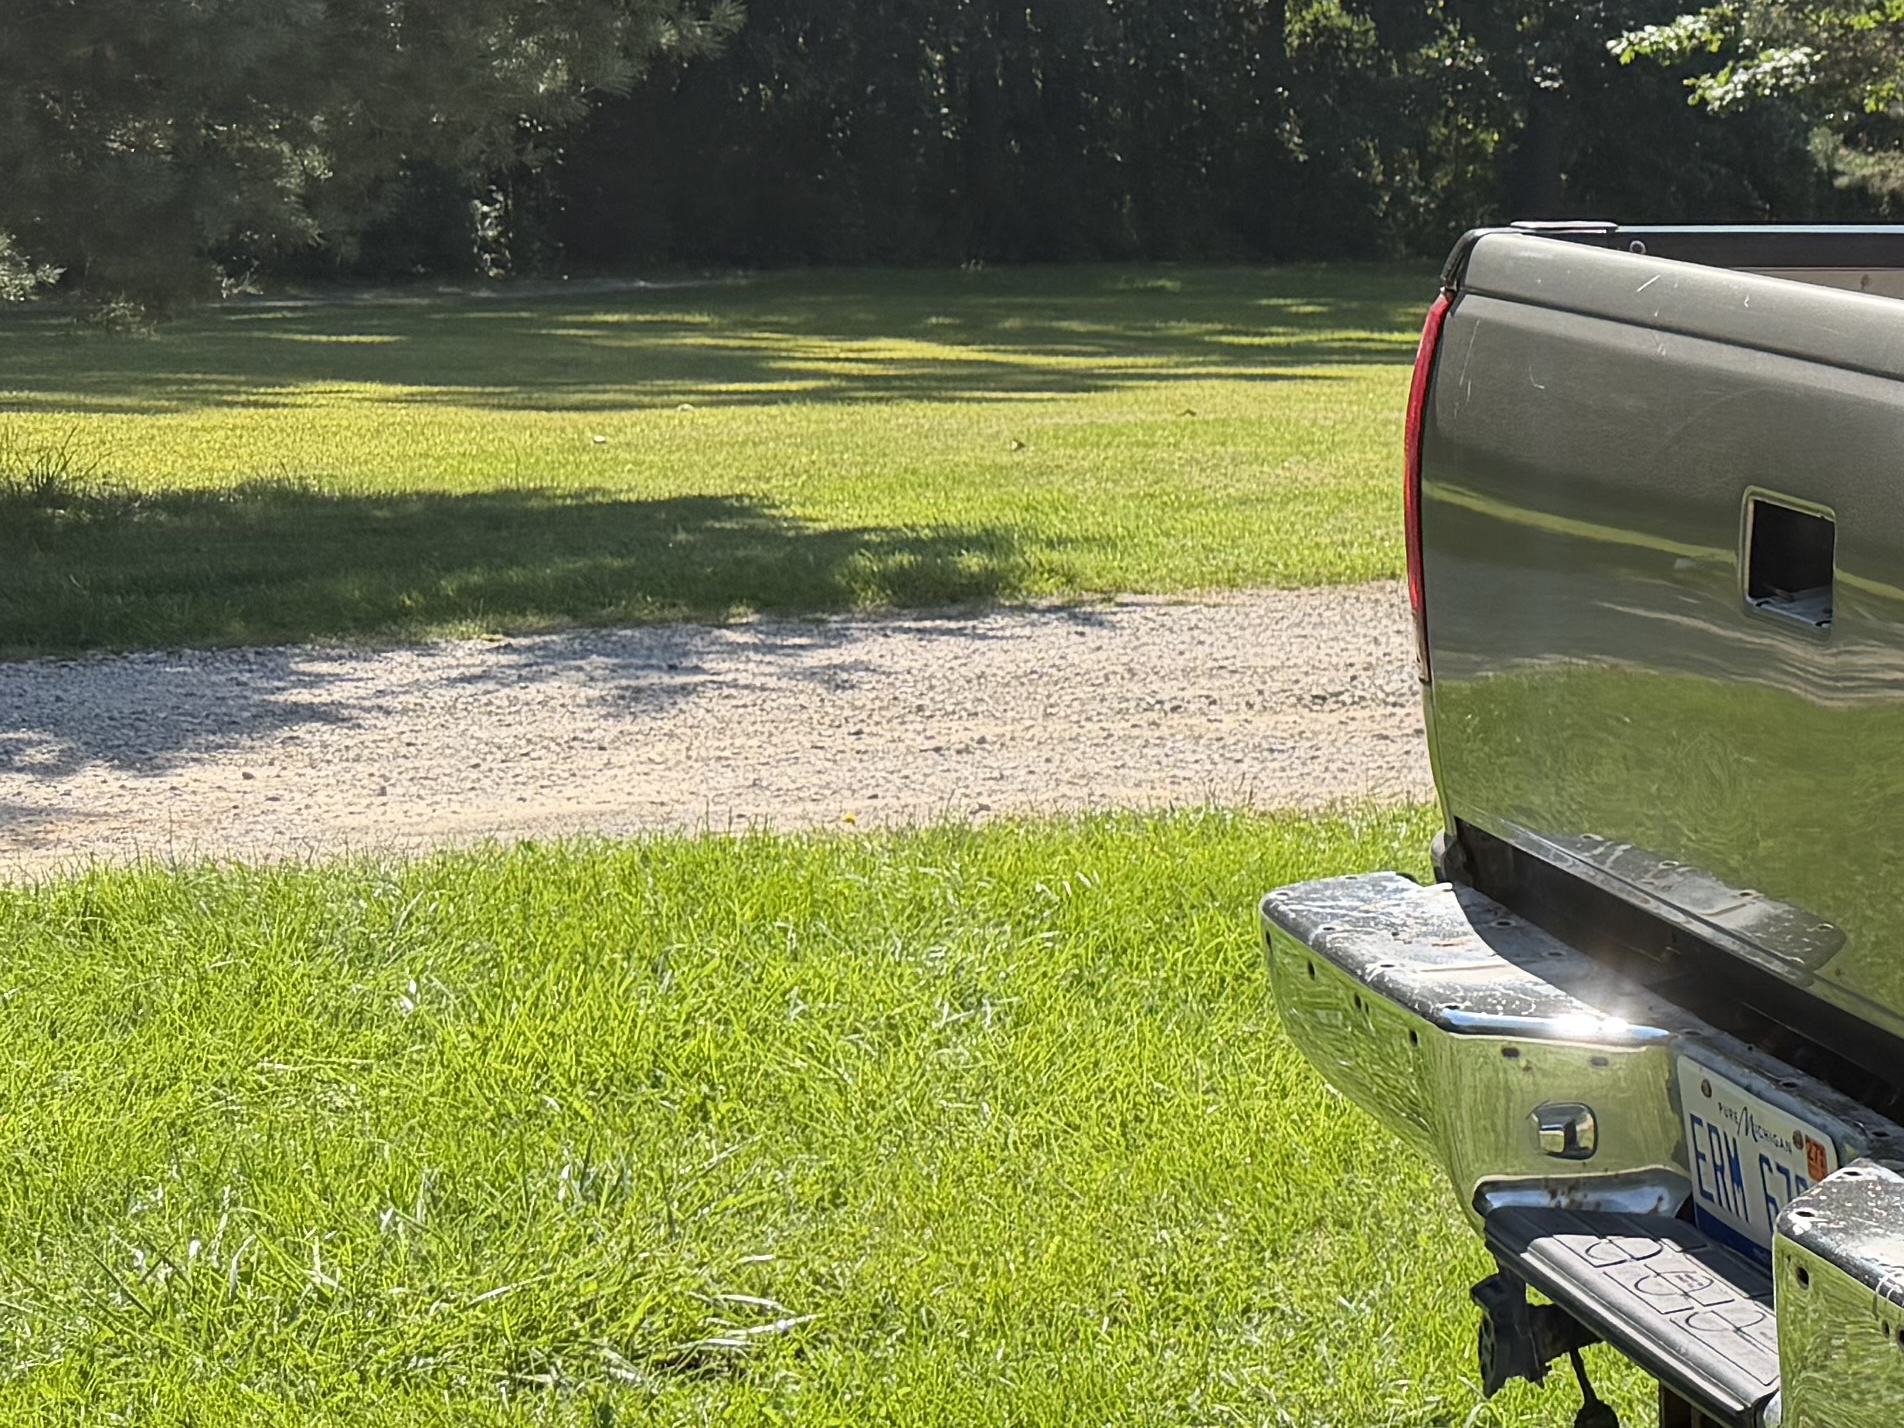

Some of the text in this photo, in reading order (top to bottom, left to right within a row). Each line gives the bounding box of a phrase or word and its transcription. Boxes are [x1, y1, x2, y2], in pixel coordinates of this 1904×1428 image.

[1690, 1113, 1750, 1224] ERM
[1717, 1101, 1793, 1154] PURE MICHIGAN
